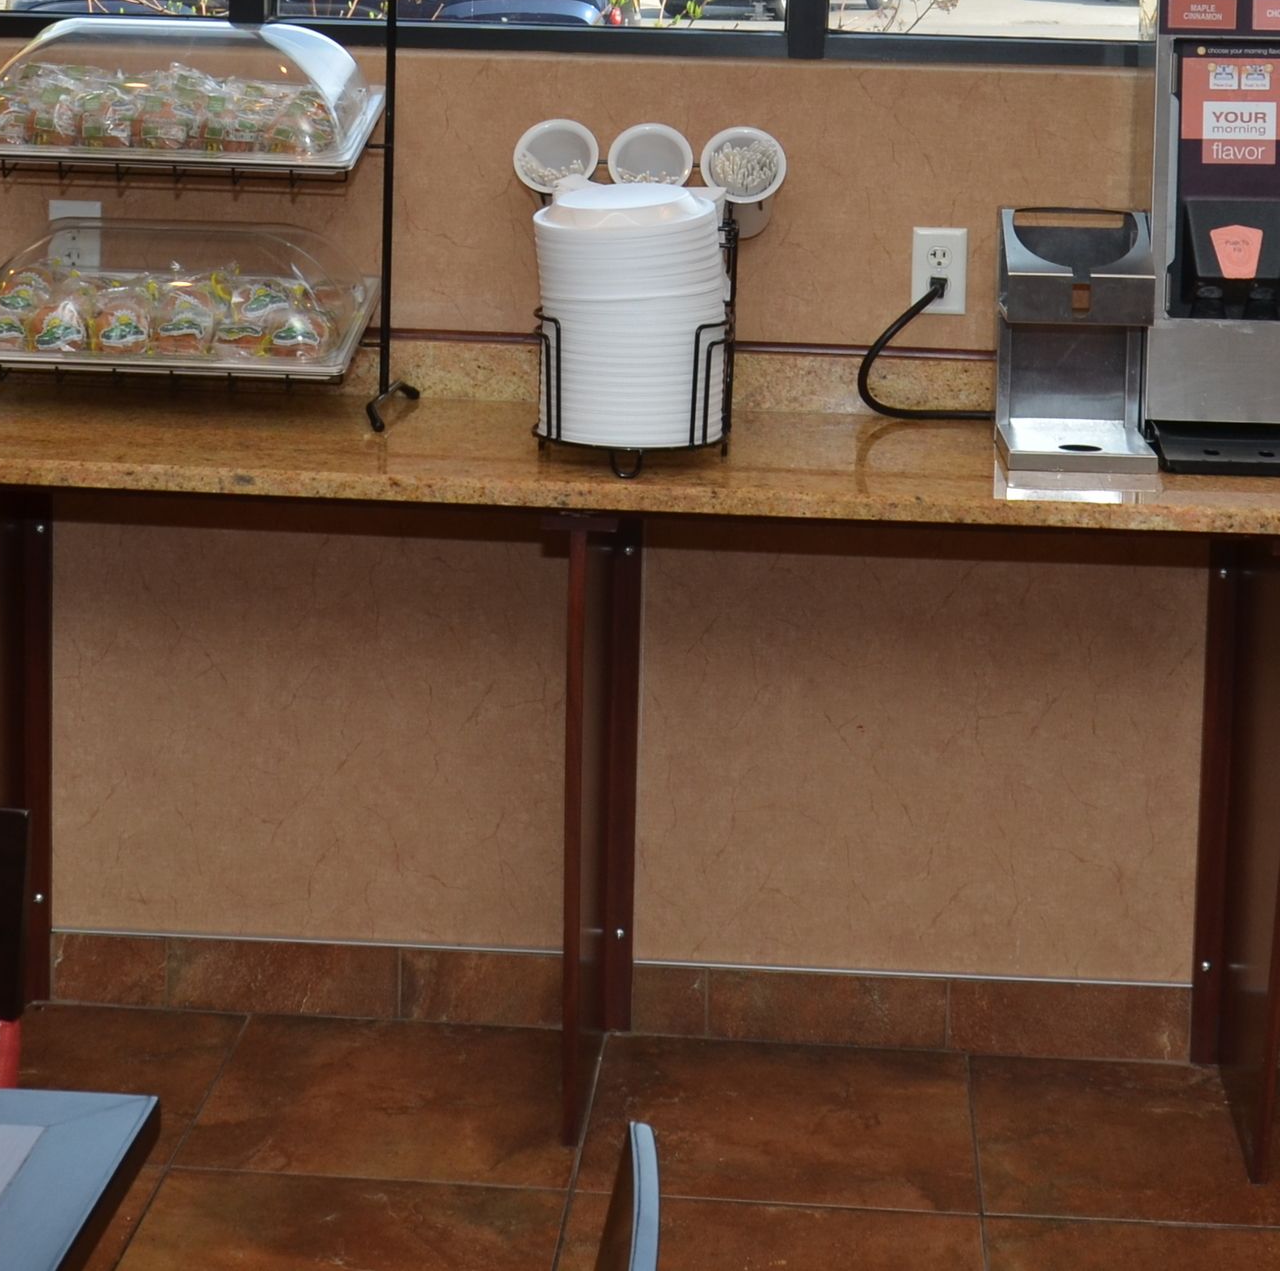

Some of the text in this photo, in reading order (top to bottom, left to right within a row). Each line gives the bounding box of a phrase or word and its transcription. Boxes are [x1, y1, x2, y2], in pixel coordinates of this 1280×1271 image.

[1190, 4, 1216, 13] MAPLE
[1183, 12, 1222, 21] CINNAMON
[1207, 47, 1230, 55] choose
[1243, 48, 1268, 56] morning
[1212, 111, 1267, 123] YOUR
[1212, 125, 1266, 136] morning
[1211, 141, 1266, 160] flavor
